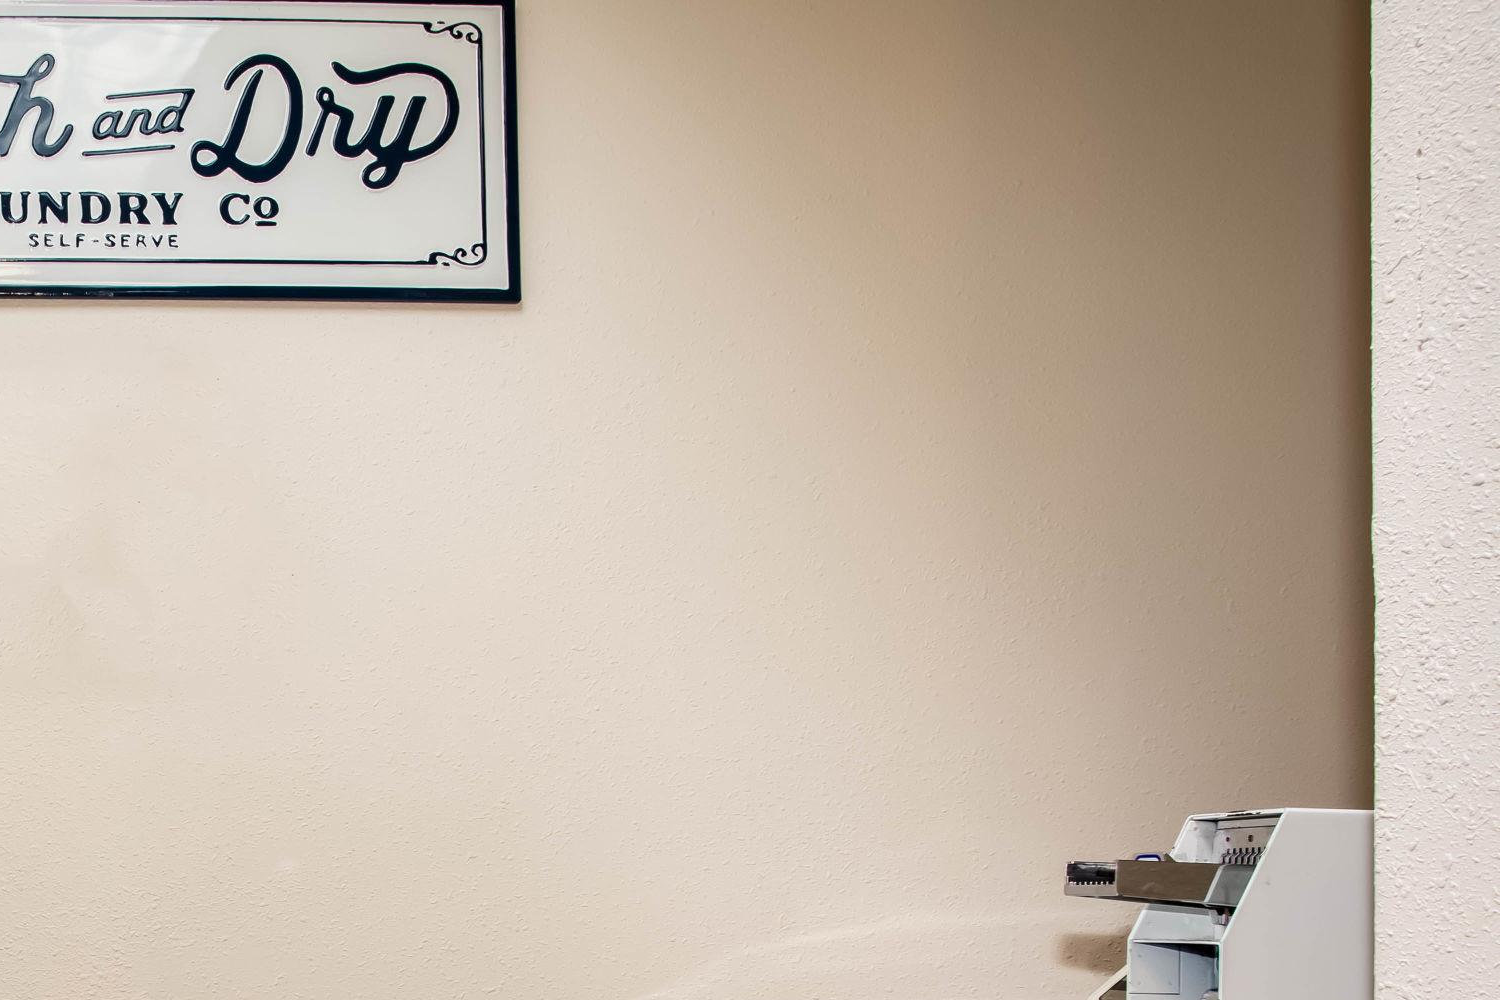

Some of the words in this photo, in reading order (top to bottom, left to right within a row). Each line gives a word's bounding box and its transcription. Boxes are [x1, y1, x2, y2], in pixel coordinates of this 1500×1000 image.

[91, 88, 196, 141] and
[190, 53, 460, 190] Dry
[28, 233, 179, 248] SELF-SERVE
